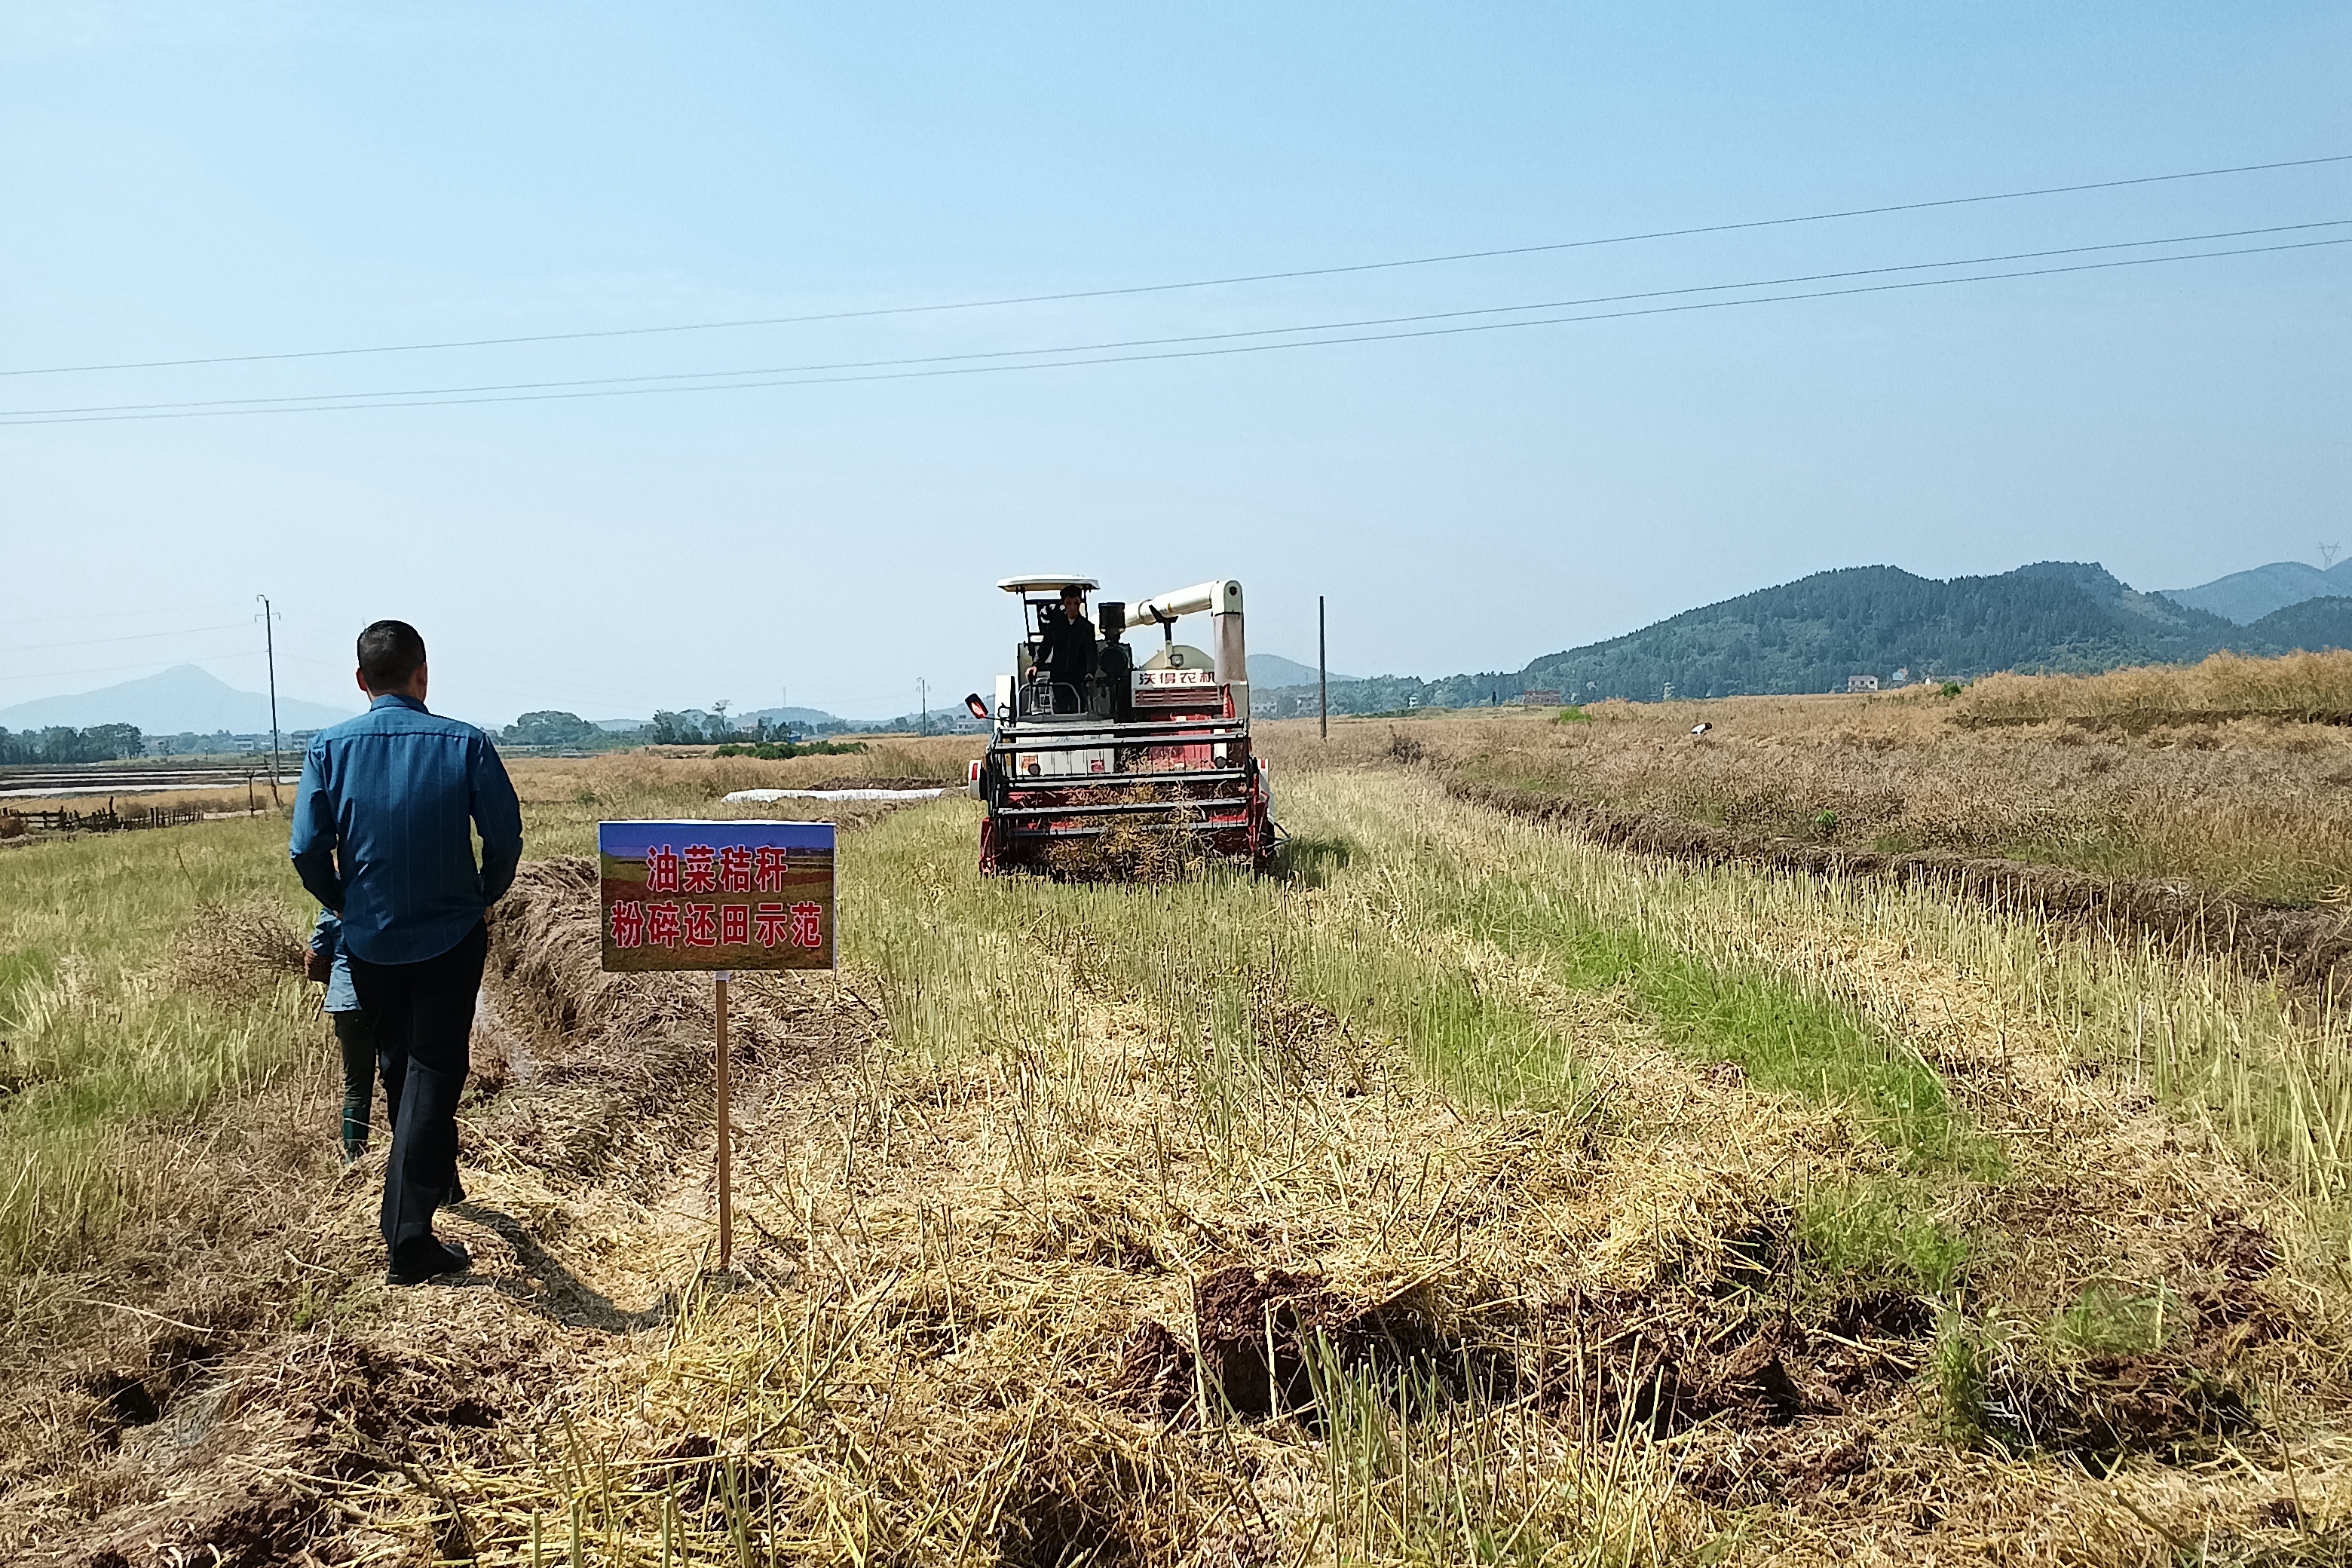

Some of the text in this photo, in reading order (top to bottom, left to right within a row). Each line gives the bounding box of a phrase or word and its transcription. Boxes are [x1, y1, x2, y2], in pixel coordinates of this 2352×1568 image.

[646, 844, 788, 893] 油菜秸秆
[610, 900, 822, 948] 粉碎还田示范
